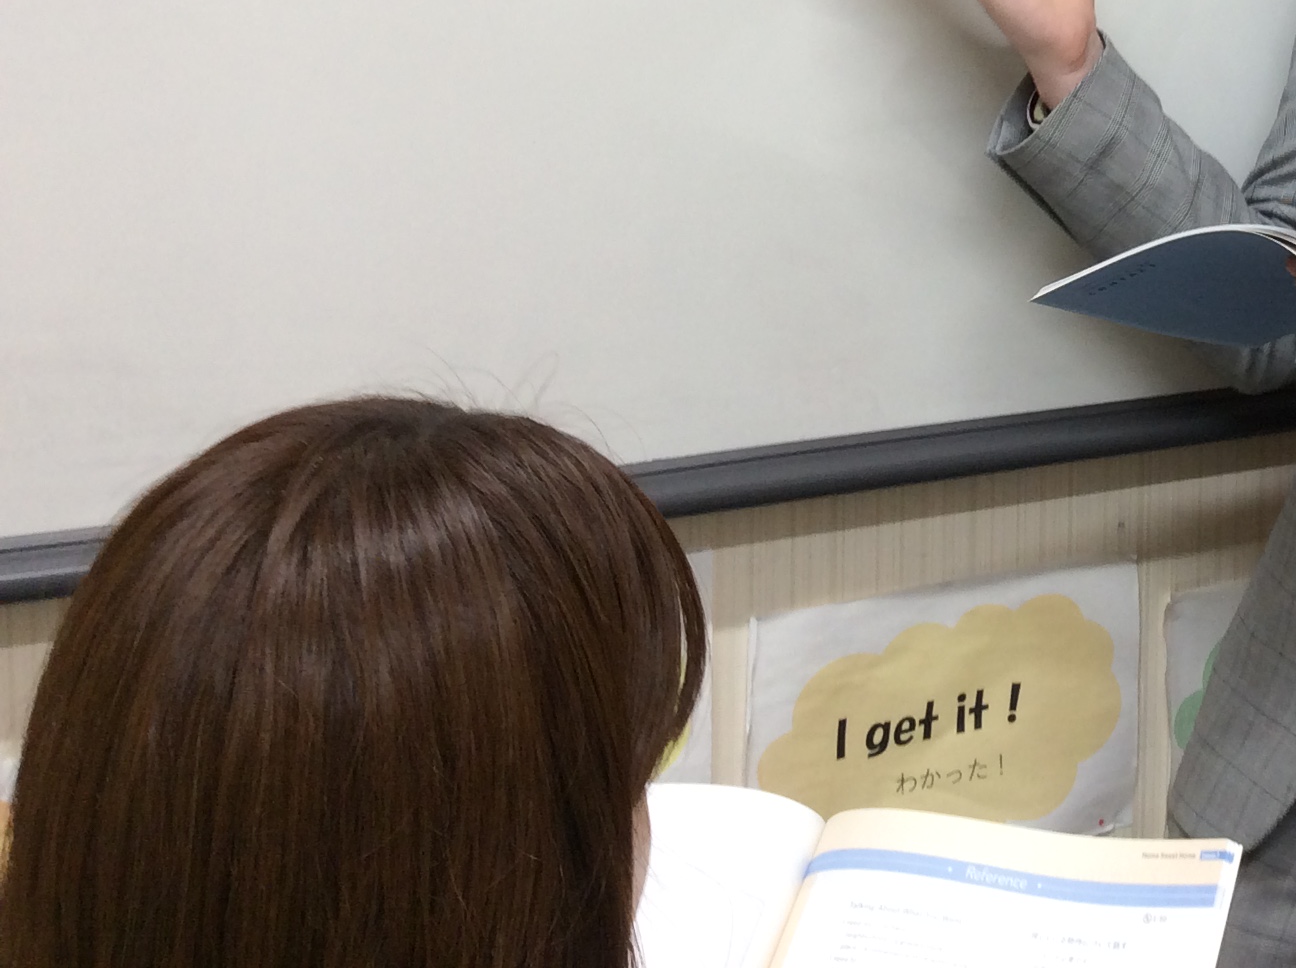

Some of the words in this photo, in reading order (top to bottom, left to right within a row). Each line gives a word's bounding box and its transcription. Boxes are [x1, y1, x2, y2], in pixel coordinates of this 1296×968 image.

[836, 718, 848, 761] I
[865, 700, 940, 759] get
[956, 688, 990, 734] it
[965, 864, 1028, 890] Reference
